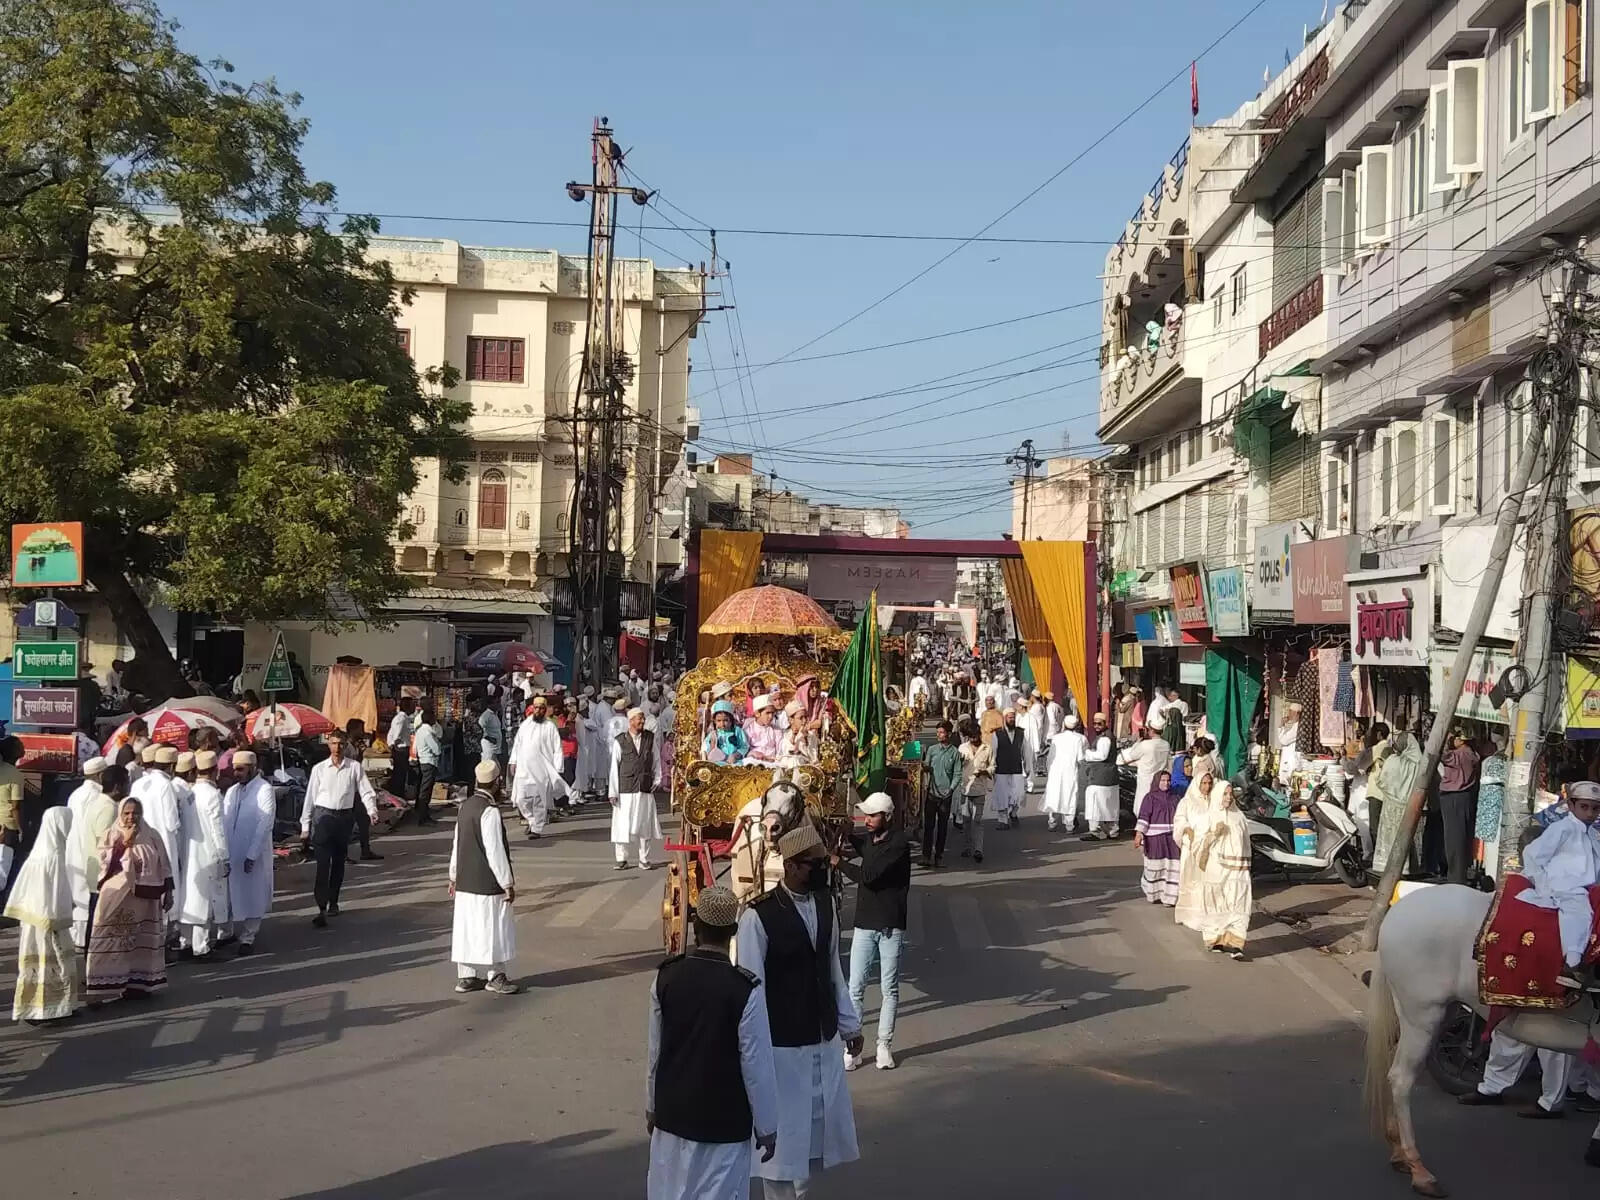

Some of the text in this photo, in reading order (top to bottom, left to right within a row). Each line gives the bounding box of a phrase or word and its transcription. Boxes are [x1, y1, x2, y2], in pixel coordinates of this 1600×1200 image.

[1260, 559, 1280, 588] opus
[24, 649, 73, 667] फतेहसागर झील
[54, 696, 73, 713] सर्कल
